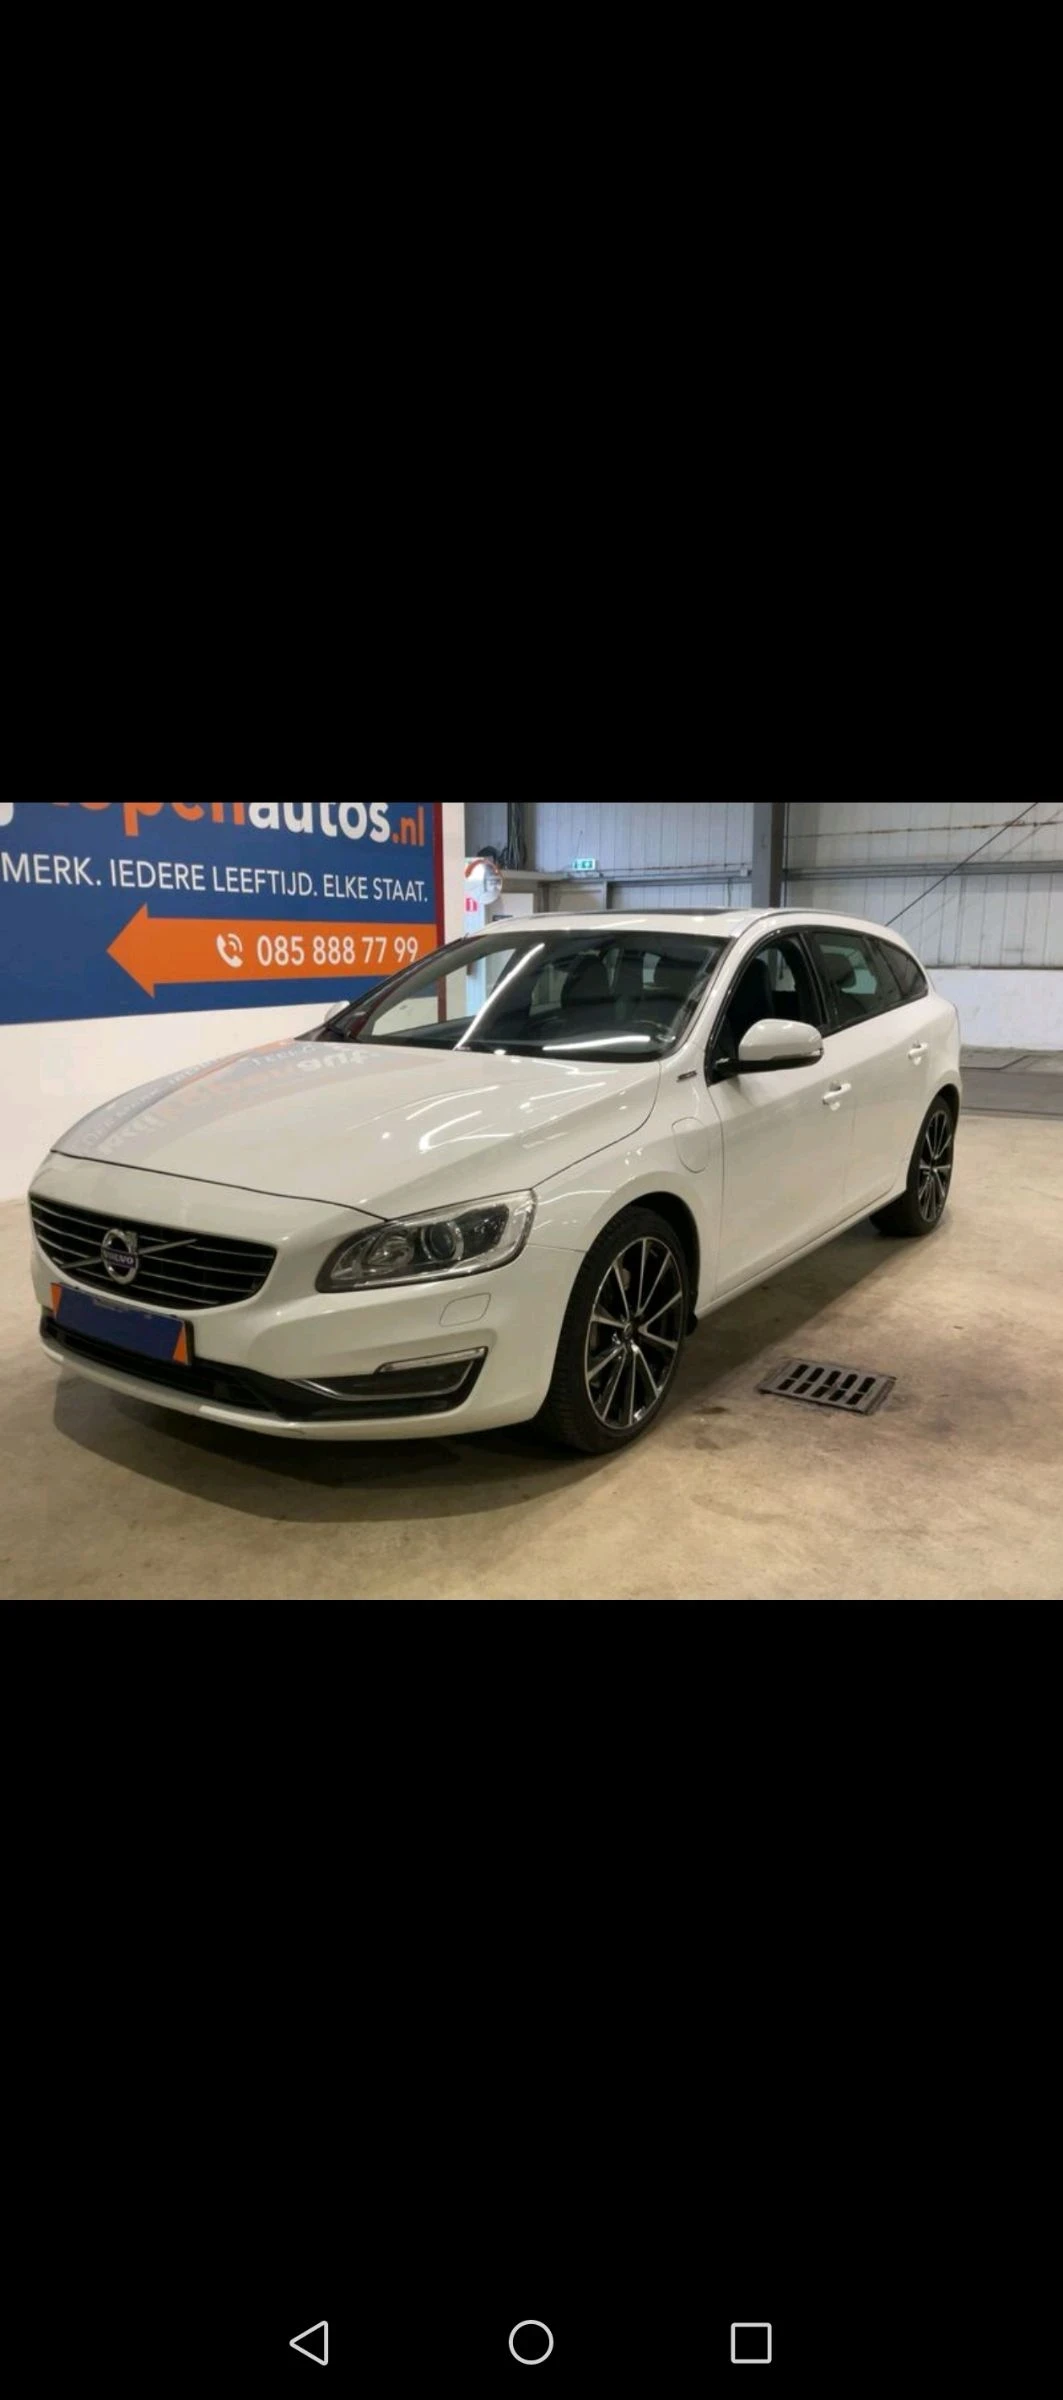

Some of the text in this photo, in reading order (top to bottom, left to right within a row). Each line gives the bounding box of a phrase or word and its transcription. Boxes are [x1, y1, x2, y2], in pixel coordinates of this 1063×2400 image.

[1, 852, 428, 902] MERK. IEDERE LEEFTIJD. ELKE STAAT.
[257, 935, 418, 966] 085 888 77 99
